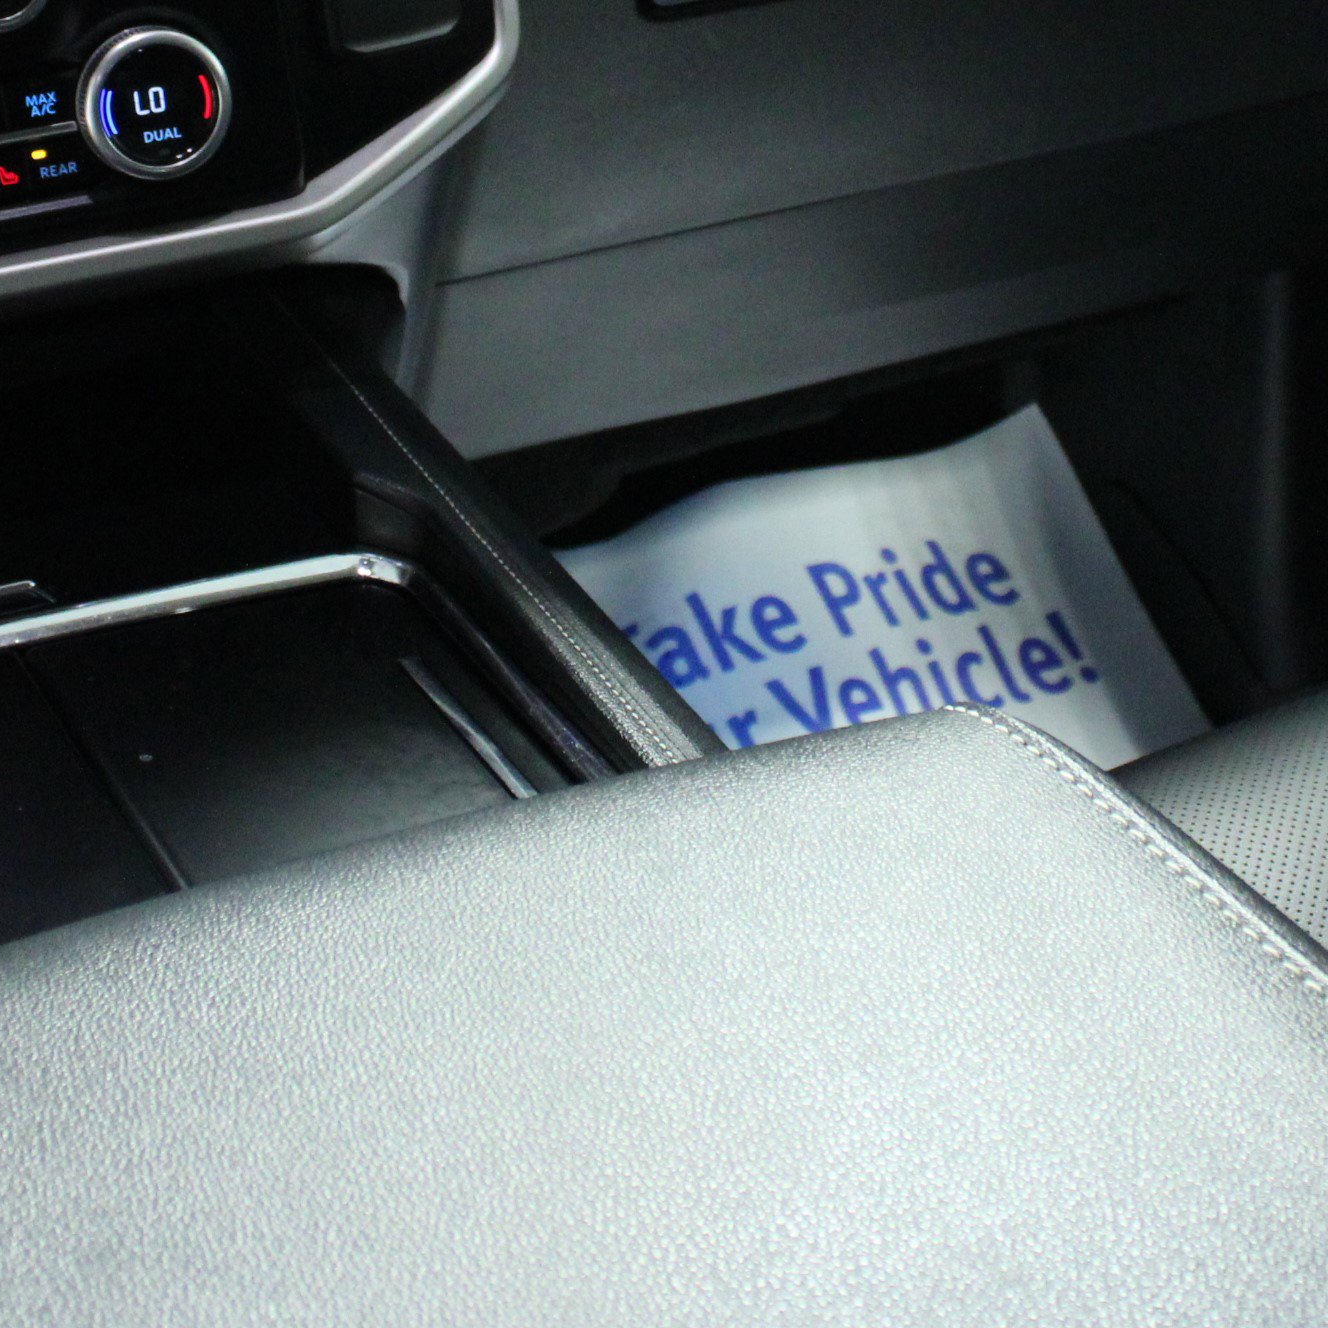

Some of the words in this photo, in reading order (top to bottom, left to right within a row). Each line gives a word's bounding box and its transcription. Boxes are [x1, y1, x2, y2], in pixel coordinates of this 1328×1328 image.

[25, 92, 57, 108] MAX
[133, 85, 166, 116] LO
[30, 102, 56, 118] A/C
[143, 127, 182, 143] DUAL
[39, 161, 78, 179] REAR
[621, 591, 808, 689] ake
[806, 540, 1020, 638] Pride
[765, 610, 1099, 733] Vehicle!
